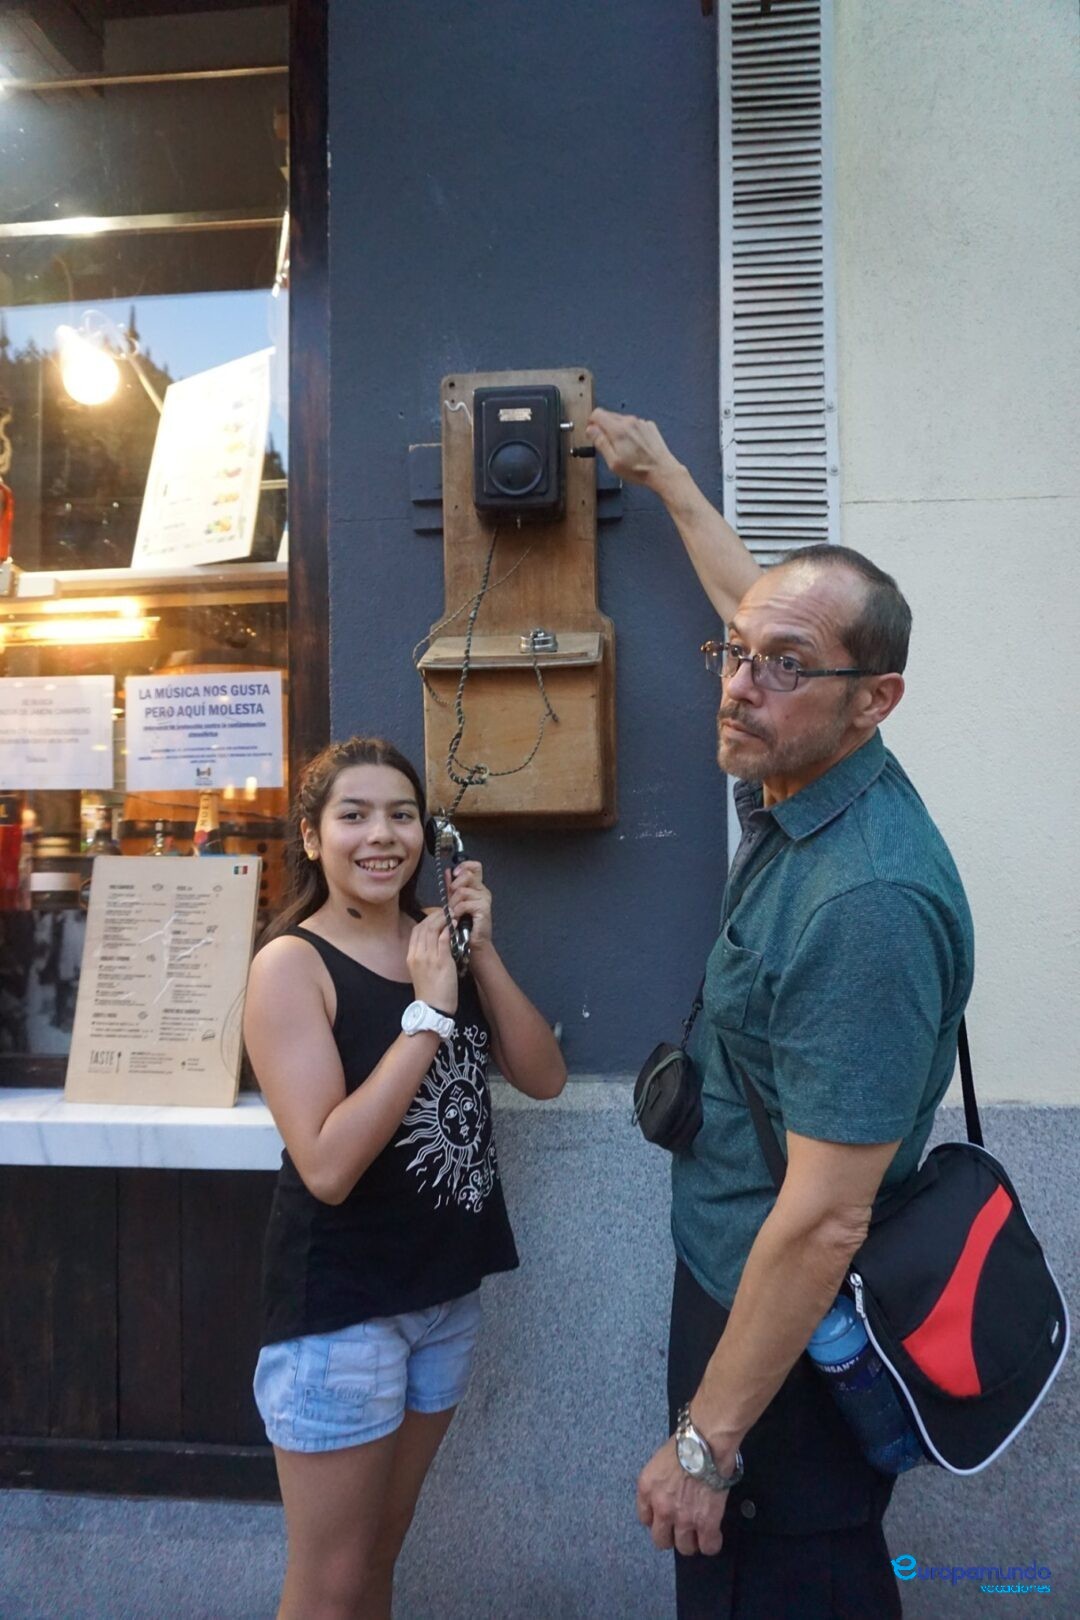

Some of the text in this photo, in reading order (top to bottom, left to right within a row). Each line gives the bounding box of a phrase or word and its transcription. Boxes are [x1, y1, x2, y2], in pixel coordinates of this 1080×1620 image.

[138, 684, 271, 700] LA MÚSICA NOS GUSTA
[144, 702, 265, 719] PERO AQUÍ MOLESTA
